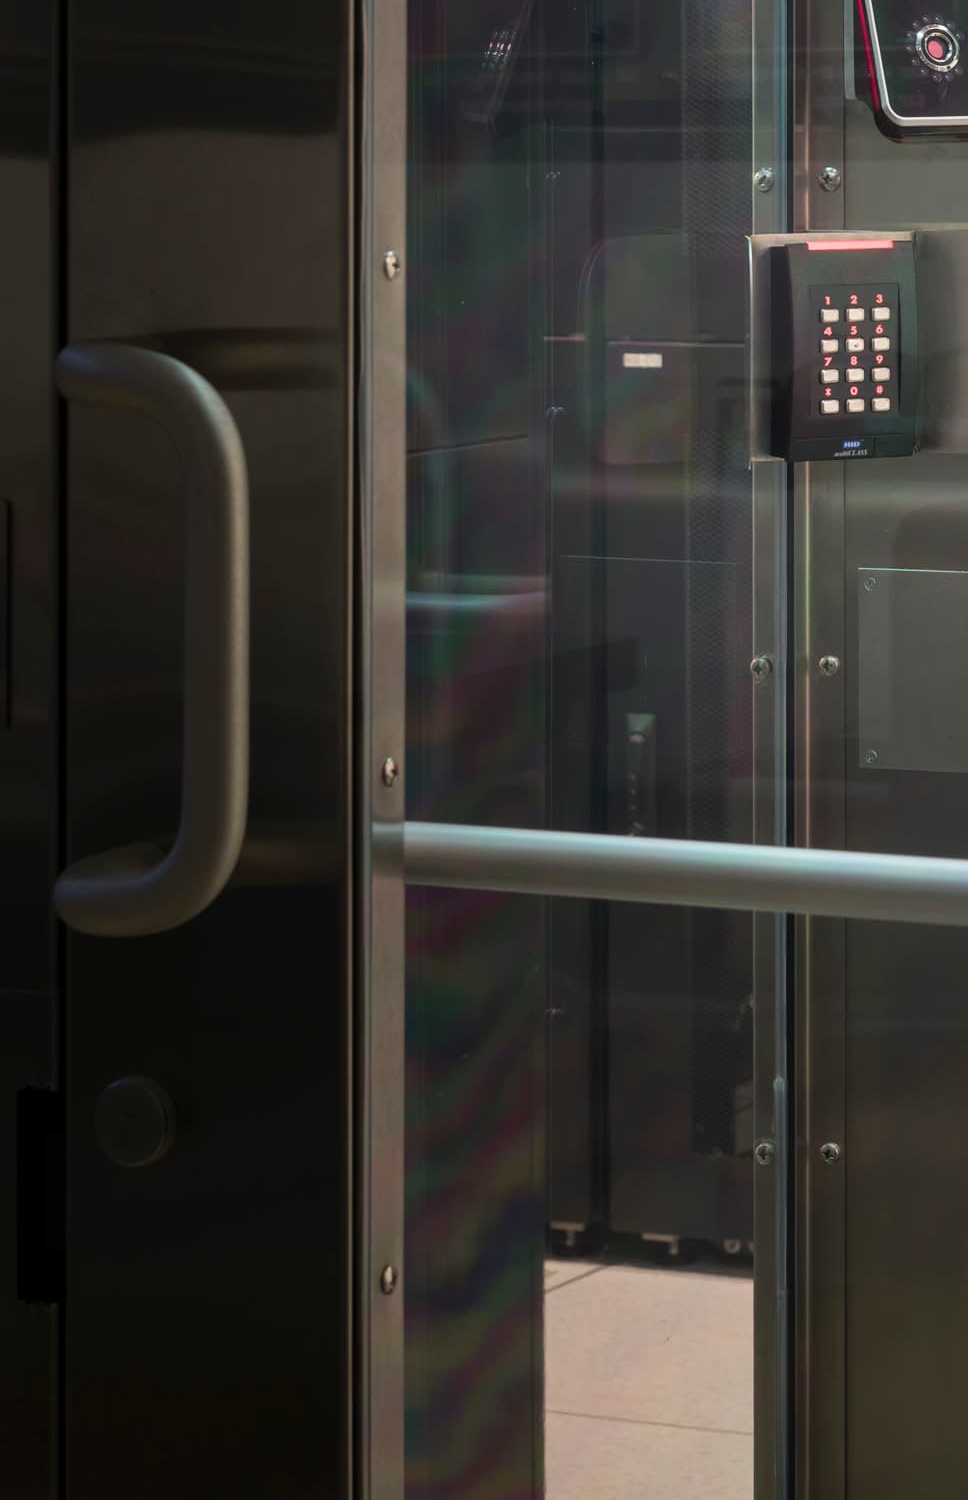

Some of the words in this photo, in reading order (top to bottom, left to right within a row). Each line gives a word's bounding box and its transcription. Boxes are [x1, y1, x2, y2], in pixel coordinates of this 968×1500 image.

[824, 295, 831, 305] 1
[850, 295, 858, 305] 2
[875, 294, 883, 304] 3
[823, 326, 832, 336] 4
[850, 326, 858, 335] 5
[875, 325, 883, 334] 6
[824, 357, 832, 367] 7
[850, 356, 858, 366] 8
[875, 355, 883, 364] 9
[850, 386, 858, 396] 0
